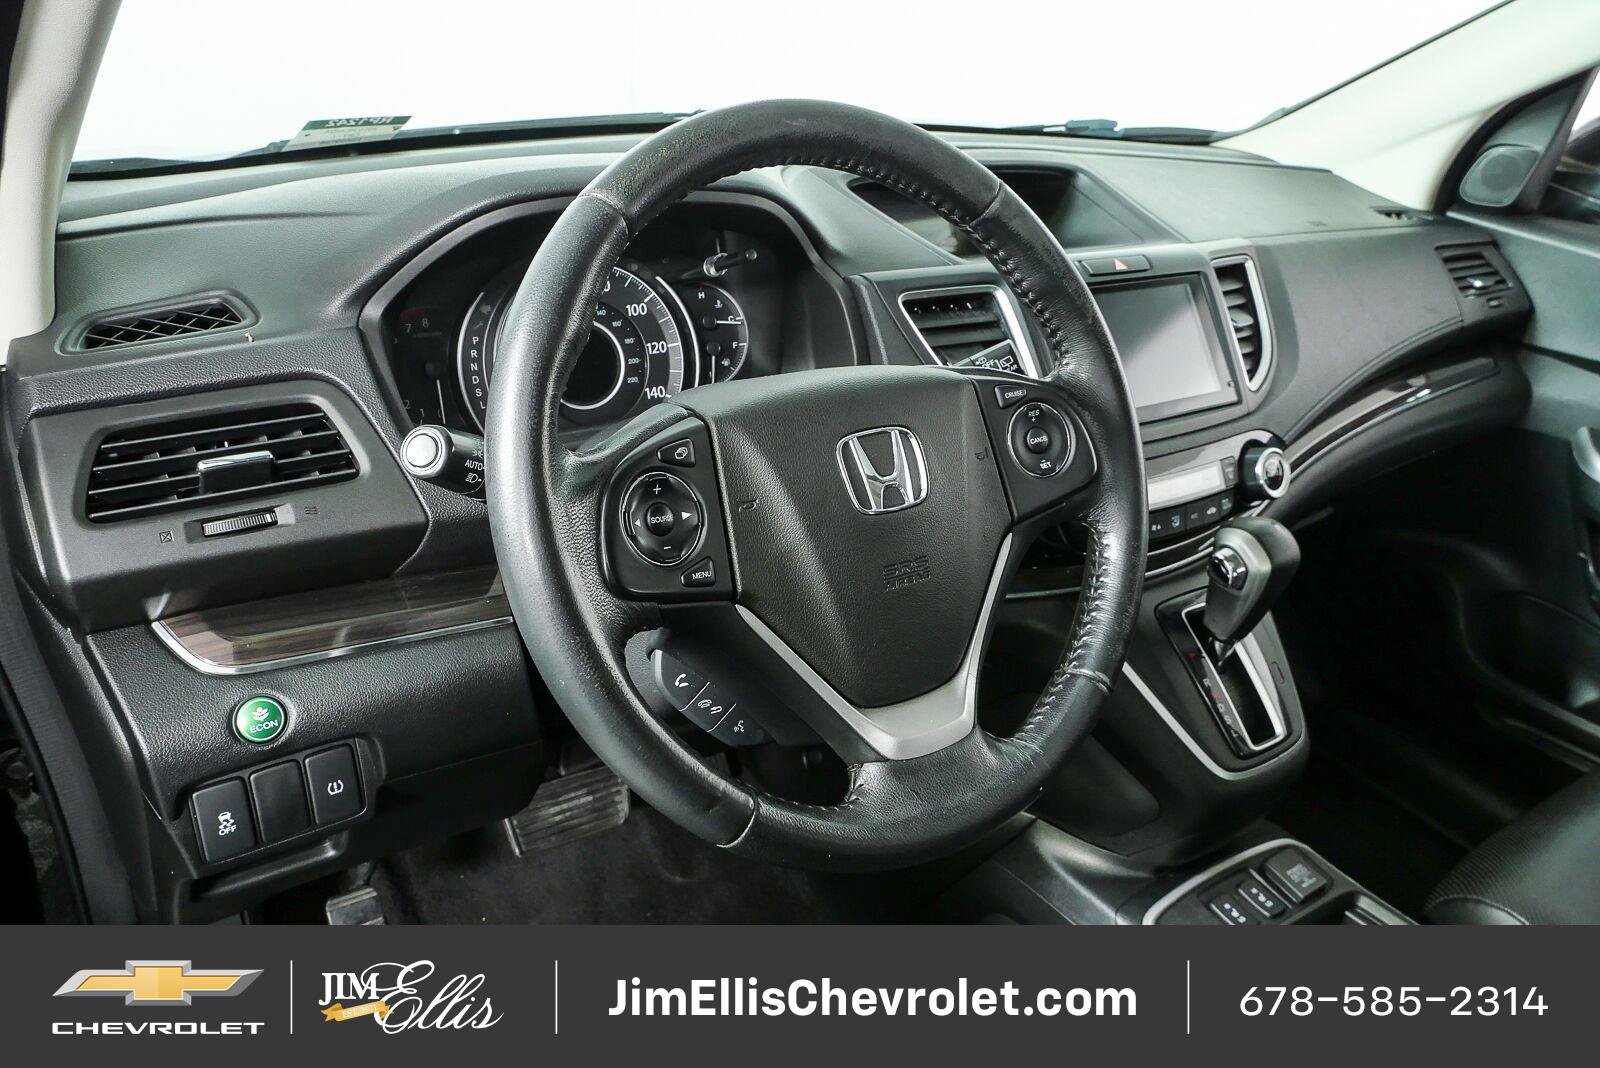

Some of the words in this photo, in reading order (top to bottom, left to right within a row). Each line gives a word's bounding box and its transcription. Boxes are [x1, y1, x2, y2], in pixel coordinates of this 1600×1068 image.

[625, 302, 648, 317] 100
[422, 318, 429, 327] 8
[472, 336, 480, 345] P
[732, 341, 739, 349] F
[646, 340, 668, 355] 120
[470, 349, 478, 359] R
[470, 362, 478, 371] N
[471, 375, 480, 385] D
[475, 388, 483, 397] S
[644, 385, 666, 400] 140
[1005, 389, 1023, 399] CRUISE
[480, 401, 486, 409] L
[1028, 409, 1040, 417] RES
[464, 458, 484, 471] AUTO
[691, 569, 713, 580] MENU
[250, 720, 278, 733] ECON
[218, 825, 237, 836] OFF
